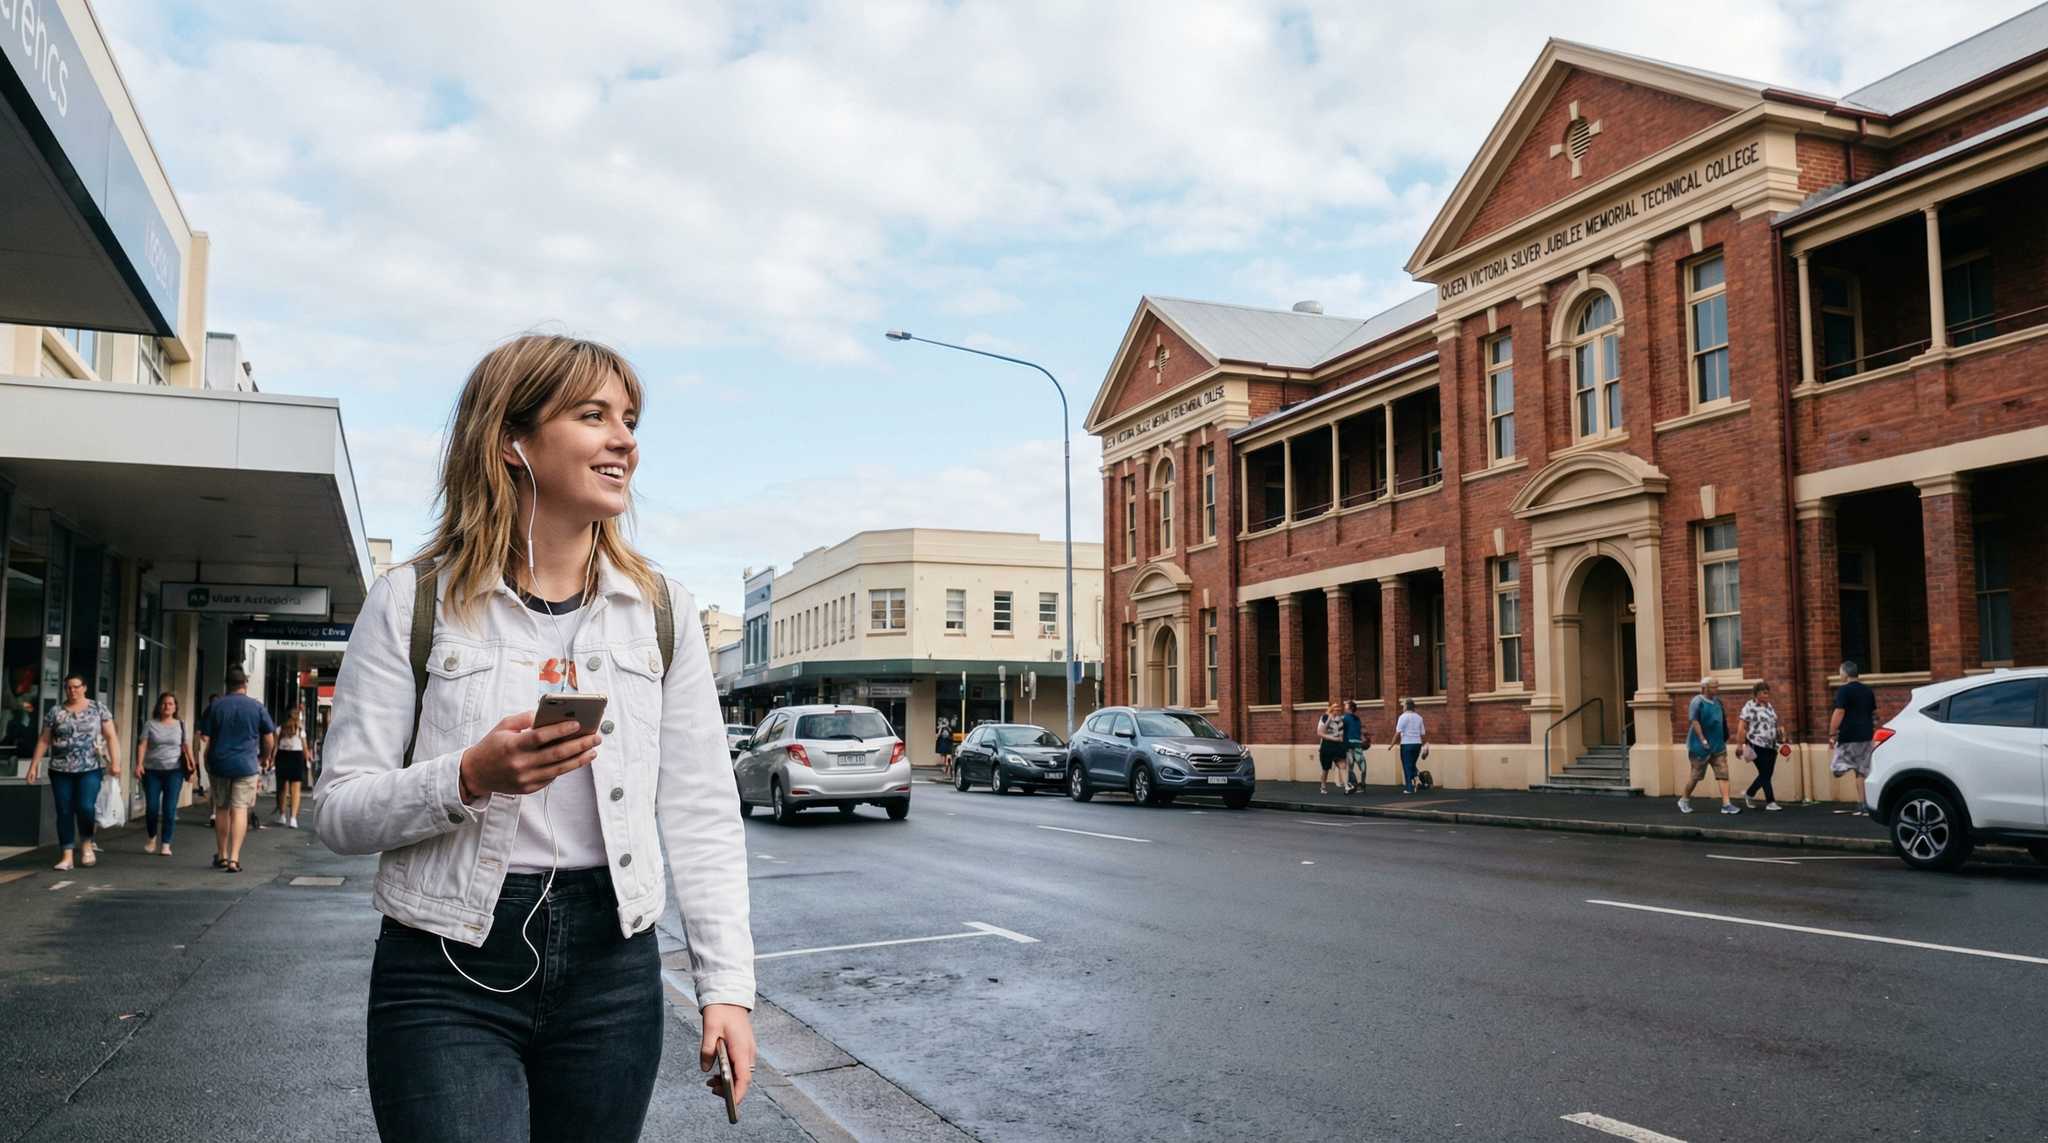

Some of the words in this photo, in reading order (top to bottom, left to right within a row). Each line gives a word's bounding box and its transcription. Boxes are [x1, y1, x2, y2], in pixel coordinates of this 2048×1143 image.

[1441, 276, 1468, 301] QUEEN
[1470, 258, 1509, 288] VICTORIA
[1511, 242, 1541, 270] SILVER
[1545, 223, 1583, 256] JUBILEE
[1585, 201, 1639, 238] MEMORIAL
[1641, 170, 1702, 212] TECHNICAL
[1705, 142, 1760, 183] COLLEGE
